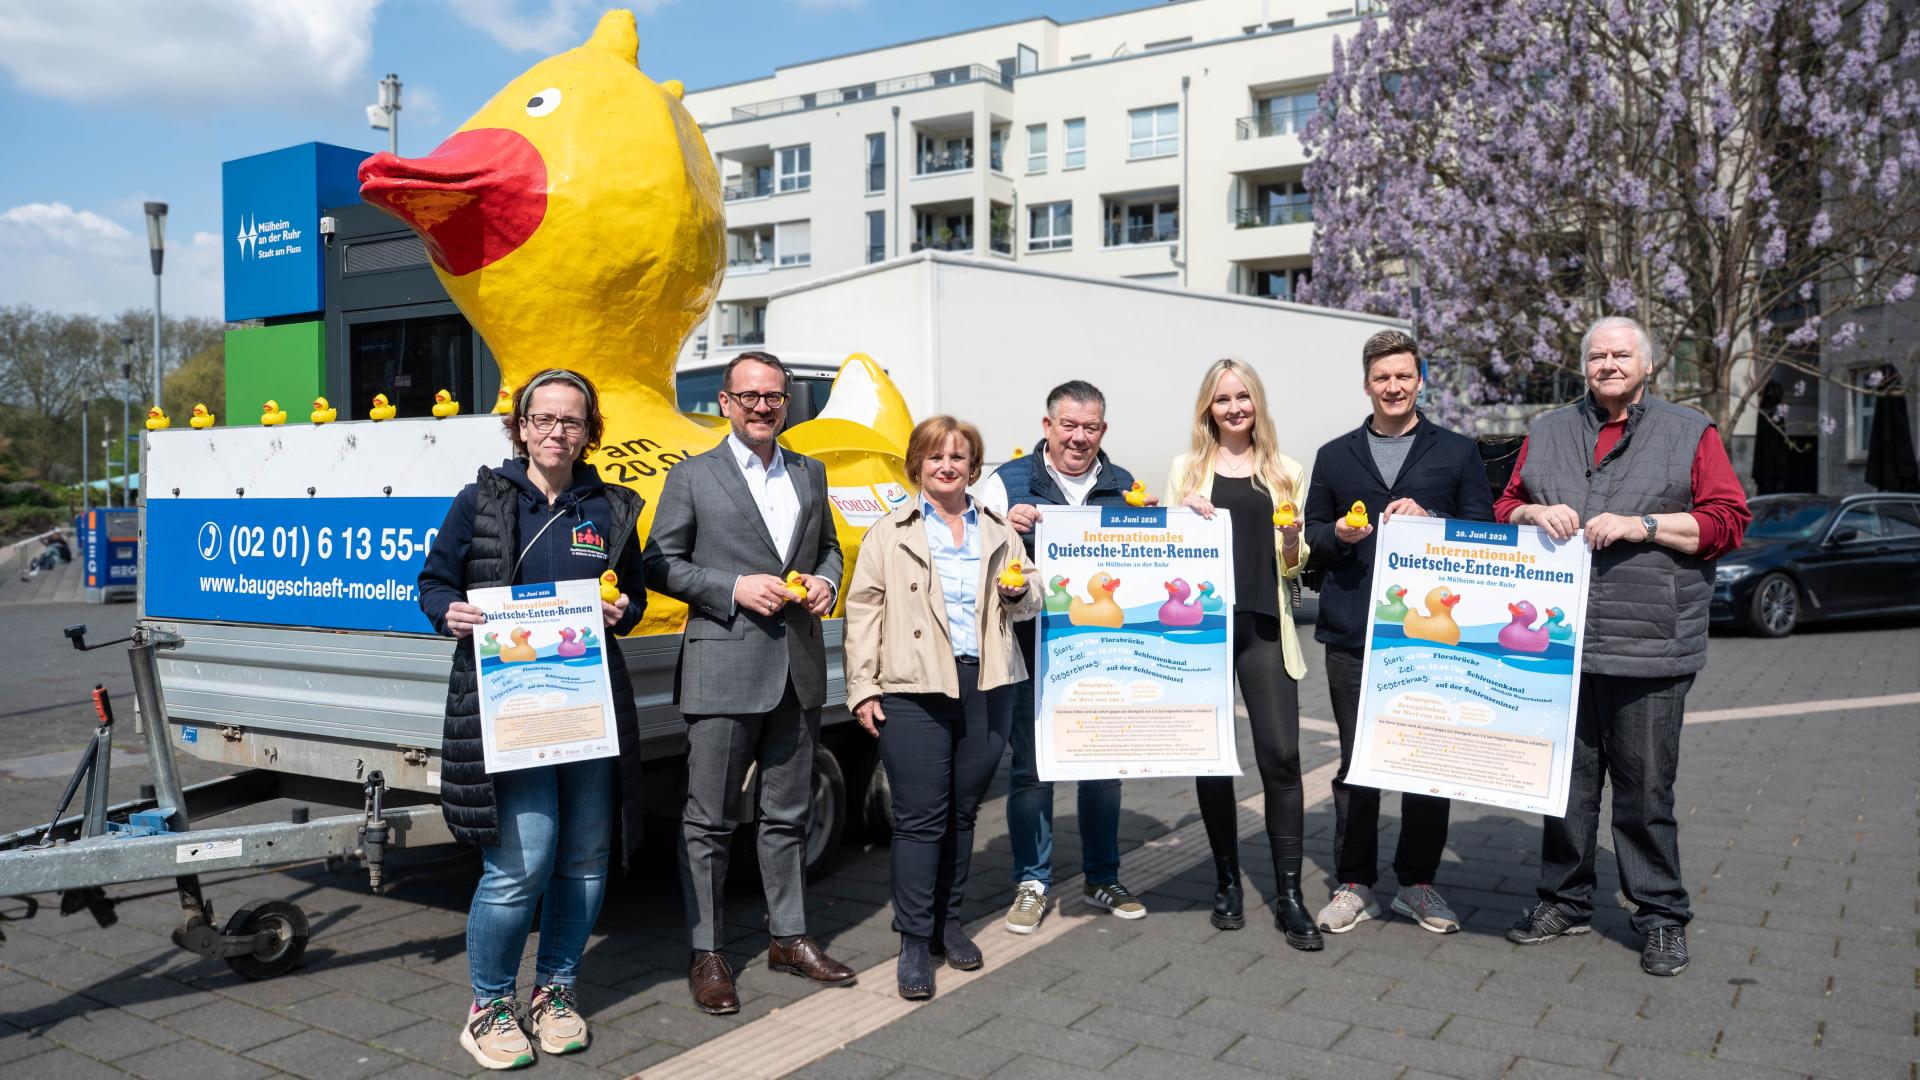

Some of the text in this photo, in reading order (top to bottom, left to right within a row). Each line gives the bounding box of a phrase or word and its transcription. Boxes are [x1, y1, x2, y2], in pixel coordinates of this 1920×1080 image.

[258, 220, 290, 234] Mülheim
[268, 233, 281, 243] der
[282, 229, 302, 240] Ruhr
[258, 249, 274, 259] Stadt
[286, 246, 302, 254] Fluss
[600, 438, 662, 458] am
[830, 495, 884, 512] FORUM
[1122, 516, 1140, 524] Juni
[1083, 530, 1184, 543] Internationales
[1456, 530, 1467, 538] 20.
[1468, 530, 1488, 540] Juni
[229, 524, 265, 565] (02
[272, 525, 310, 567] 01)
[317, 527, 333, 559] 6
[342, 526, 372, 561] 13
[1048, 542, 1220, 560] Quietsche-Enten-Rennen
[1425, 542, 1536, 564] Internationales
[1388, 552, 1574, 584] Quietsche-Enten-Rennen
[200, 574, 420, 602] www.baugeschaeft-moeller.
[1446, 576, 1475, 585] Mülheim
[1486, 579, 1497, 587] der
[1498, 581, 1516, 590] Ruhr
[503, 599, 569, 610] Internationales
[481, 604, 593, 623] Quietsche-Enten-Rennen
[1134, 650, 1187, 666] Schleusenkanal
[1384, 656, 1404, 666] Start:
[1433, 652, 1480, 667] Florabrücke
[1133, 666, 1184, 684] Schleuseninsel
[1466, 670, 1525, 694] Schleusenkanal
[1464, 686, 1519, 712] Schleuseninsel
